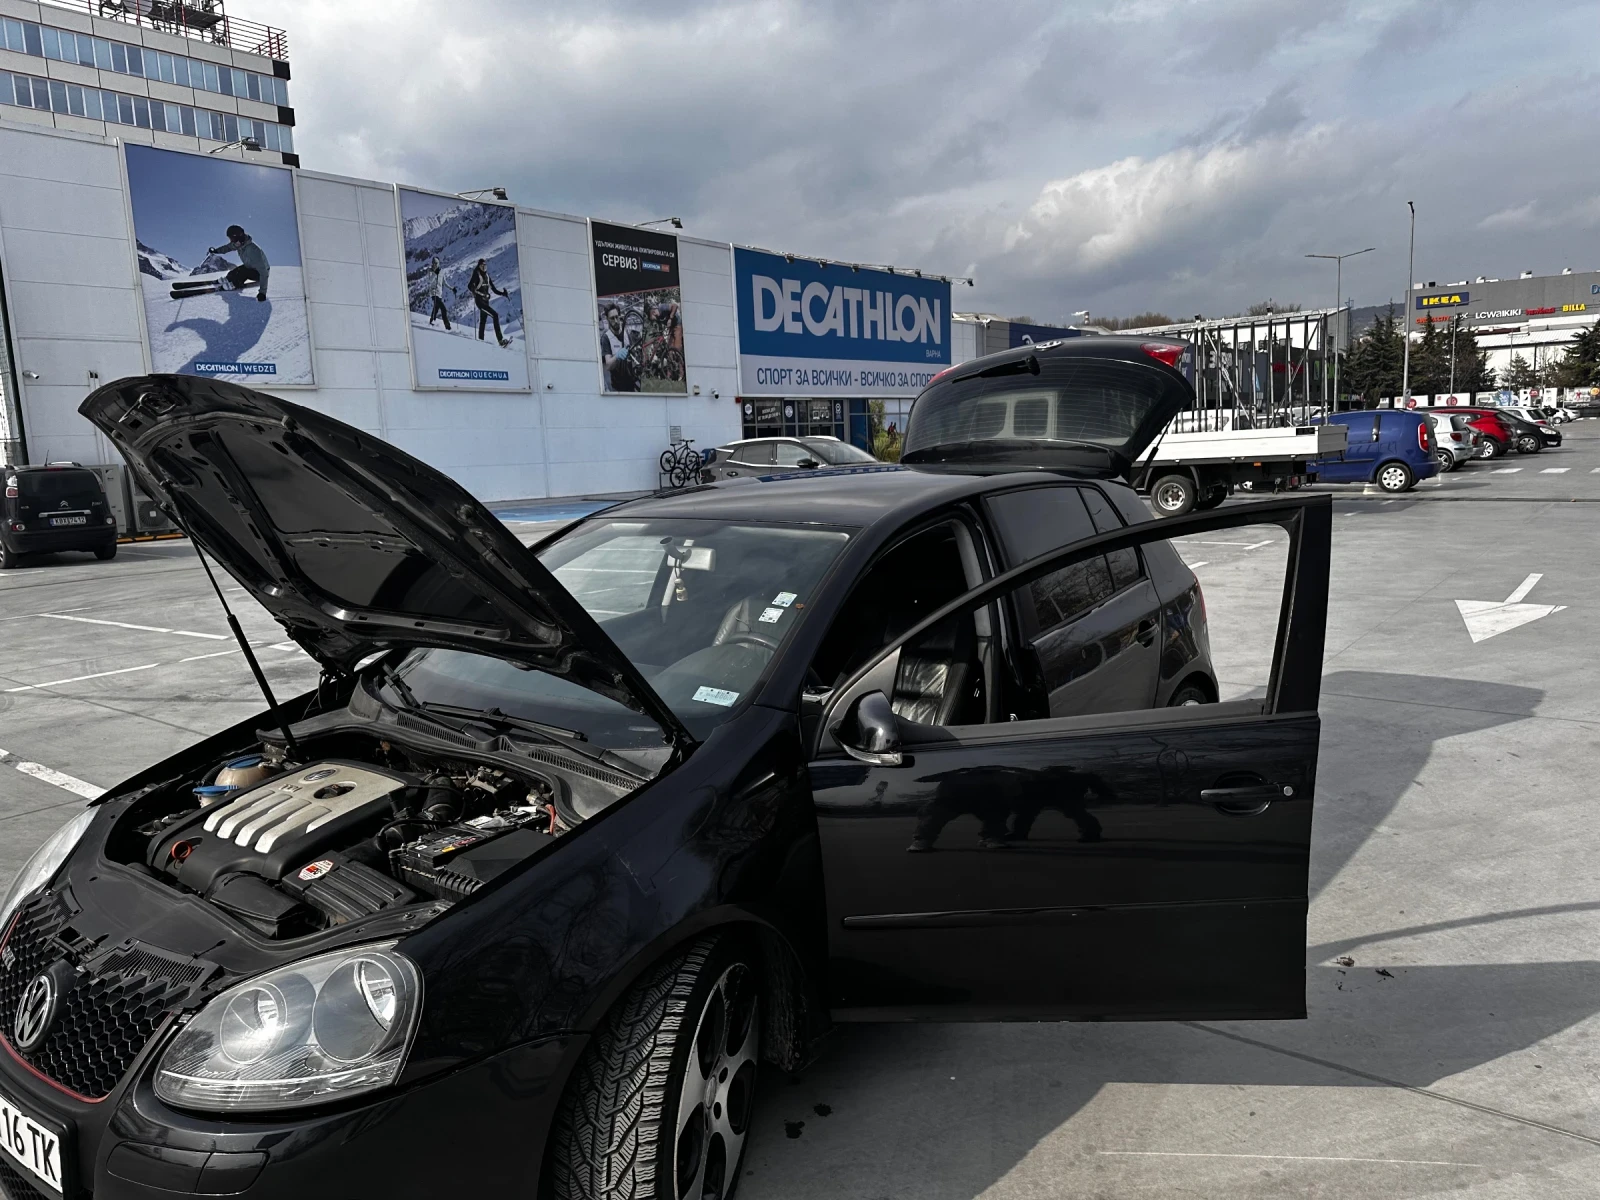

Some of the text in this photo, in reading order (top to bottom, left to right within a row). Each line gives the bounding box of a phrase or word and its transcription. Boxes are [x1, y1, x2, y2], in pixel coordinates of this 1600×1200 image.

[602, 253, 638, 270] СЕРВИЗ
[1422, 295, 1461, 306] IKEA
[752, 274, 942, 345] DECATHLON
[1562, 303, 1586, 312] BILLA
[925, 350, 942, 359] ВАРНА
[195, 363, 275, 373] DECATHLON WEDZE
[440, 370, 508, 379] DECATHLON QUECHUA
[757, 368, 793, 386] СПОРТ
[795, 369, 809, 386] ЗА
[812, 369, 852, 387] ВСИЧКИ
[861, 371, 896, 387] ВСИЧКО
[897, 372, 909, 387] ЗА
[0, 1106, 58, 1183] 16 TK
